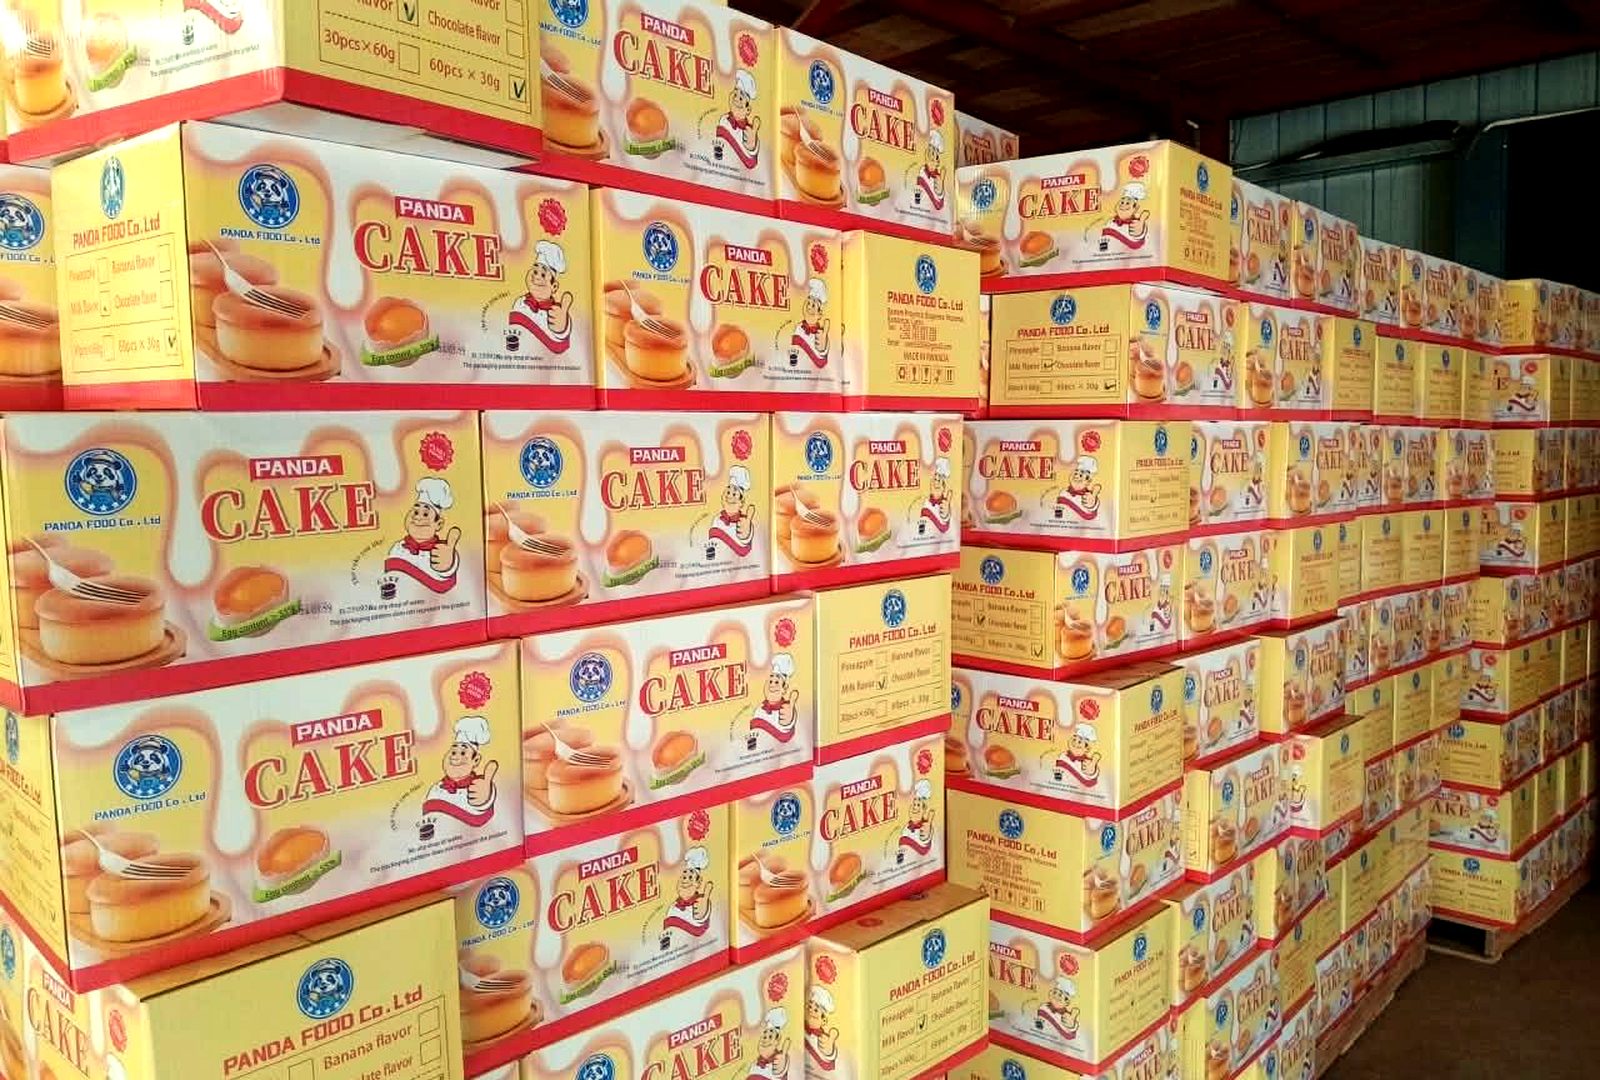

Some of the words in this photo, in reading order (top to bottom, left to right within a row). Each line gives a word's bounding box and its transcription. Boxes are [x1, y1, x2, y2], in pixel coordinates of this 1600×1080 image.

[428, 11, 475, 38] Chocolate
[476, 27, 500, 45] flavor
[644, 17, 690, 43] PANDA
[430, 58, 462, 79] 60pcs
[480, 71, 500, 91] 30g
[614, 29, 715, 99] CAKE
[870, 91, 901, 110] PANDA
[851, 103, 915, 152] CAKE
[1043, 177, 1081, 188] PANDA
[400, 200, 464, 222] PANDA
[1018, 188, 1100, 220] CAKE
[73, 229, 99, 249] PANDA
[102, 222, 125, 241] FOOD
[220, 228, 254, 239] PANDA
[256, 231, 281, 241] FOOD
[353, 220, 503, 281] CAKE
[727, 249, 768, 264] PANDA
[700, 264, 790, 310] CAKE
[888, 291, 914, 305] PANDA
[916, 295, 936, 308] FOOD
[1018, 328, 1047, 337] PANDA
[1050, 326, 1073, 336] FOOD
[1175, 324, 1215, 351] CAKE
[371, 354, 385, 363] Egg
[632, 449, 680, 463] PANDA
[871, 442, 902, 454] PANDA
[1002, 442, 1036, 451] PANDA
[254, 458, 331, 477] PANDA
[849, 457, 922, 494] CAKE
[979, 455, 1056, 480] CAKE
[1210, 452, 1249, 474] CAKE
[507, 491, 530, 499] PANDA
[601, 468, 707, 513] CAKE
[44, 521, 83, 531] PANDA
[87, 519, 116, 529] FOOD
[144, 516, 161, 525] Ltd
[200, 479, 379, 544] CAKE
[952, 582, 978, 592] PANDA
[980, 585, 1002, 594] FOOD
[1105, 575, 1150, 604] CAKE
[222, 629, 236, 639] Egg
[849, 633, 880, 649] PANDA
[883, 628, 906, 641] FOOD
[672, 647, 721, 665] PANDA
[639, 661, 749, 716] CAKE
[557, 707, 580, 717] PANDA
[1000, 699, 1034, 711] PANDA
[296, 714, 373, 741] PANDA
[976, 707, 1054, 741] CAKE
[244, 730, 417, 809] CAKE
[842, 780, 878, 798] PANDA
[94, 808, 132, 820] PANDA
[134, 800, 163, 813] FOOD
[819, 790, 898, 844] CAKE
[967, 829, 995, 844] PANDA
[998, 838, 1022, 850] FOOD
[580, 851, 632, 877] PANDA
[547, 863, 660, 935] CAKE
[890, 980, 921, 1000] PANDA
[923, 966, 946, 986] FOOD
[27, 986, 91, 1077] CAKE
[671, 1018, 717, 1045] PANDA
[223, 1035, 296, 1077] PANDA
[301, 1013, 354, 1046] FOOD
[324, 1042, 373, 1071] Banana
[376, 1024, 413, 1049] flavor
[641, 1027, 745, 1080] CAKE
[383, 1055, 413, 1077] flavor
